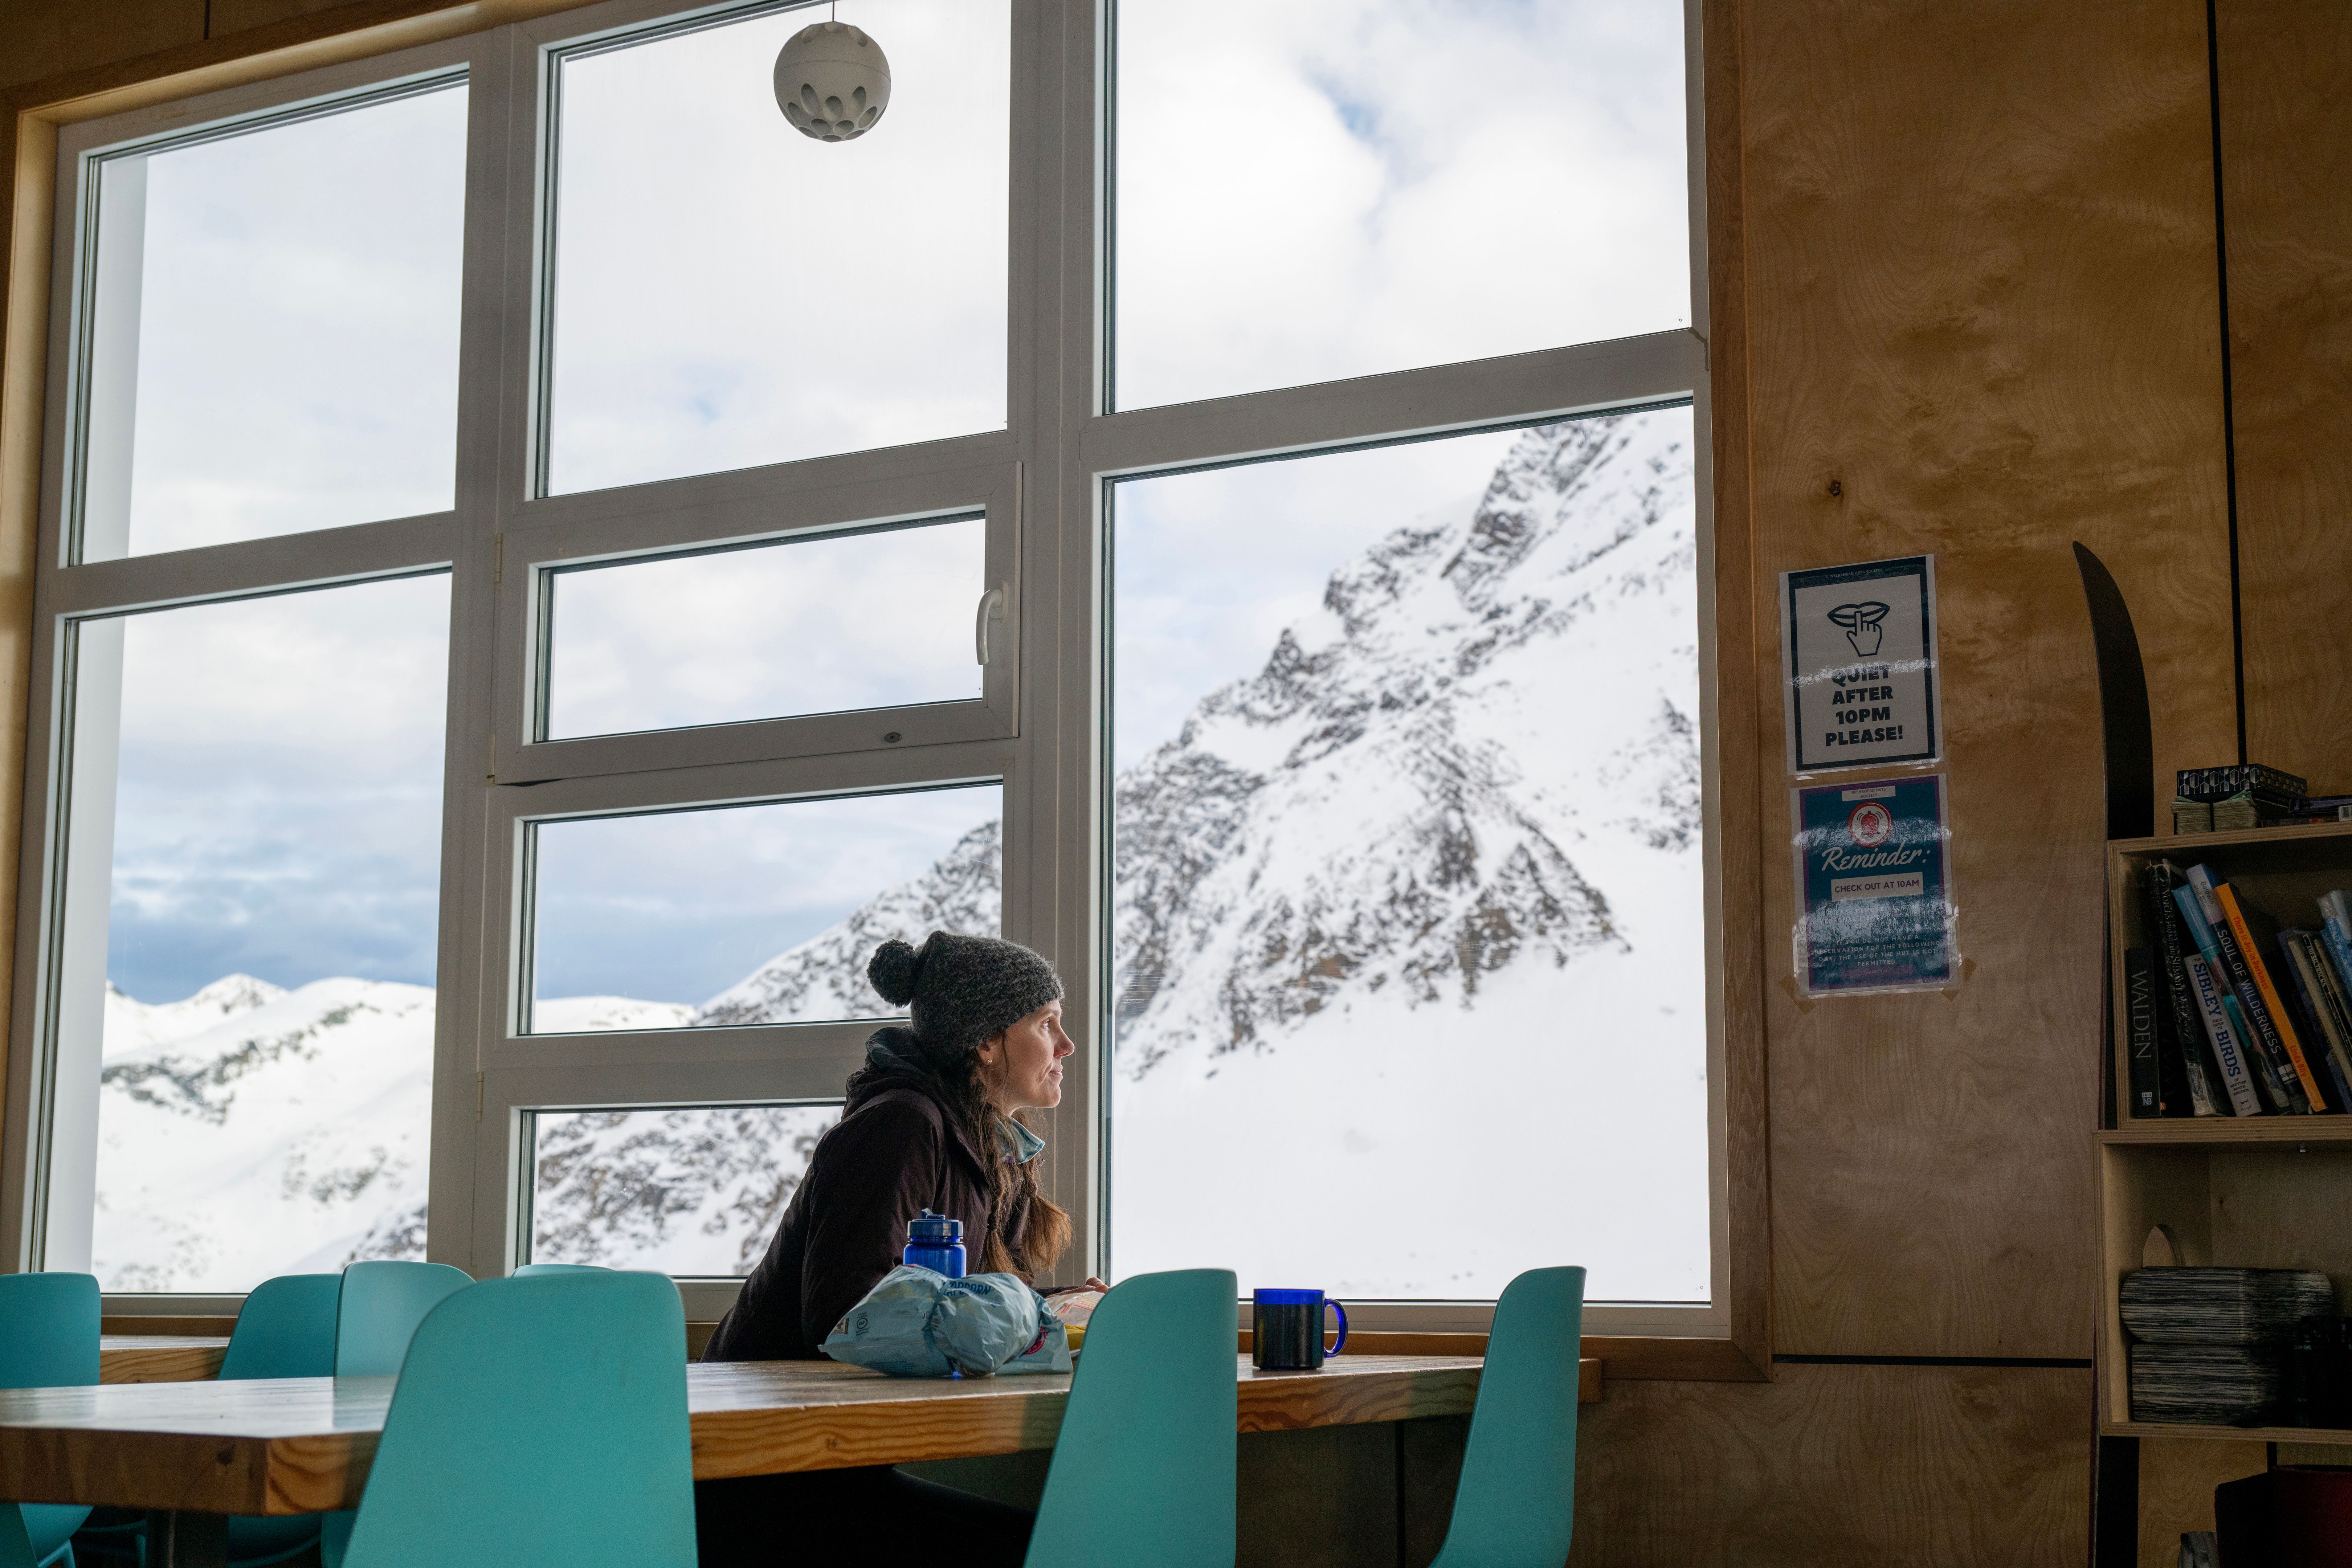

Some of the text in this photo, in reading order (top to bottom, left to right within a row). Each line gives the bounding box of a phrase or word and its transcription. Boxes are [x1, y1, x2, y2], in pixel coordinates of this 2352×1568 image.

[1832, 665, 1890, 687] QUIET
[1832, 686, 1894, 705] AFTER
[1836, 707, 1890, 725] 10PM
[1826, 725, 1903, 747] PLEASE!
[1821, 840, 1930, 871] Reminder:
[1834, 879, 1919, 893] CHECK OUT AT 10AM
[2193, 883, 2202, 895] and
[2200, 880, 2215, 905] Baldwin
[2232, 916, 2243, 935] There
[2242, 942, 2253, 953] Joy
[2252, 961, 2269, 990] Darkness
[2314, 963, 2327, 987] TRACKS
[2193, 963, 2222, 1016] SIBLEY
[2217, 929, 2282, 1054] SOUL OF WILDERNESS
[2131, 970, 2152, 1059] WALDEN
[2216, 1029, 2241, 1077] BIRDS
[2289, 1045, 2301, 1064] Linda
[2230, 1080, 2247, 1088] WESTERN
